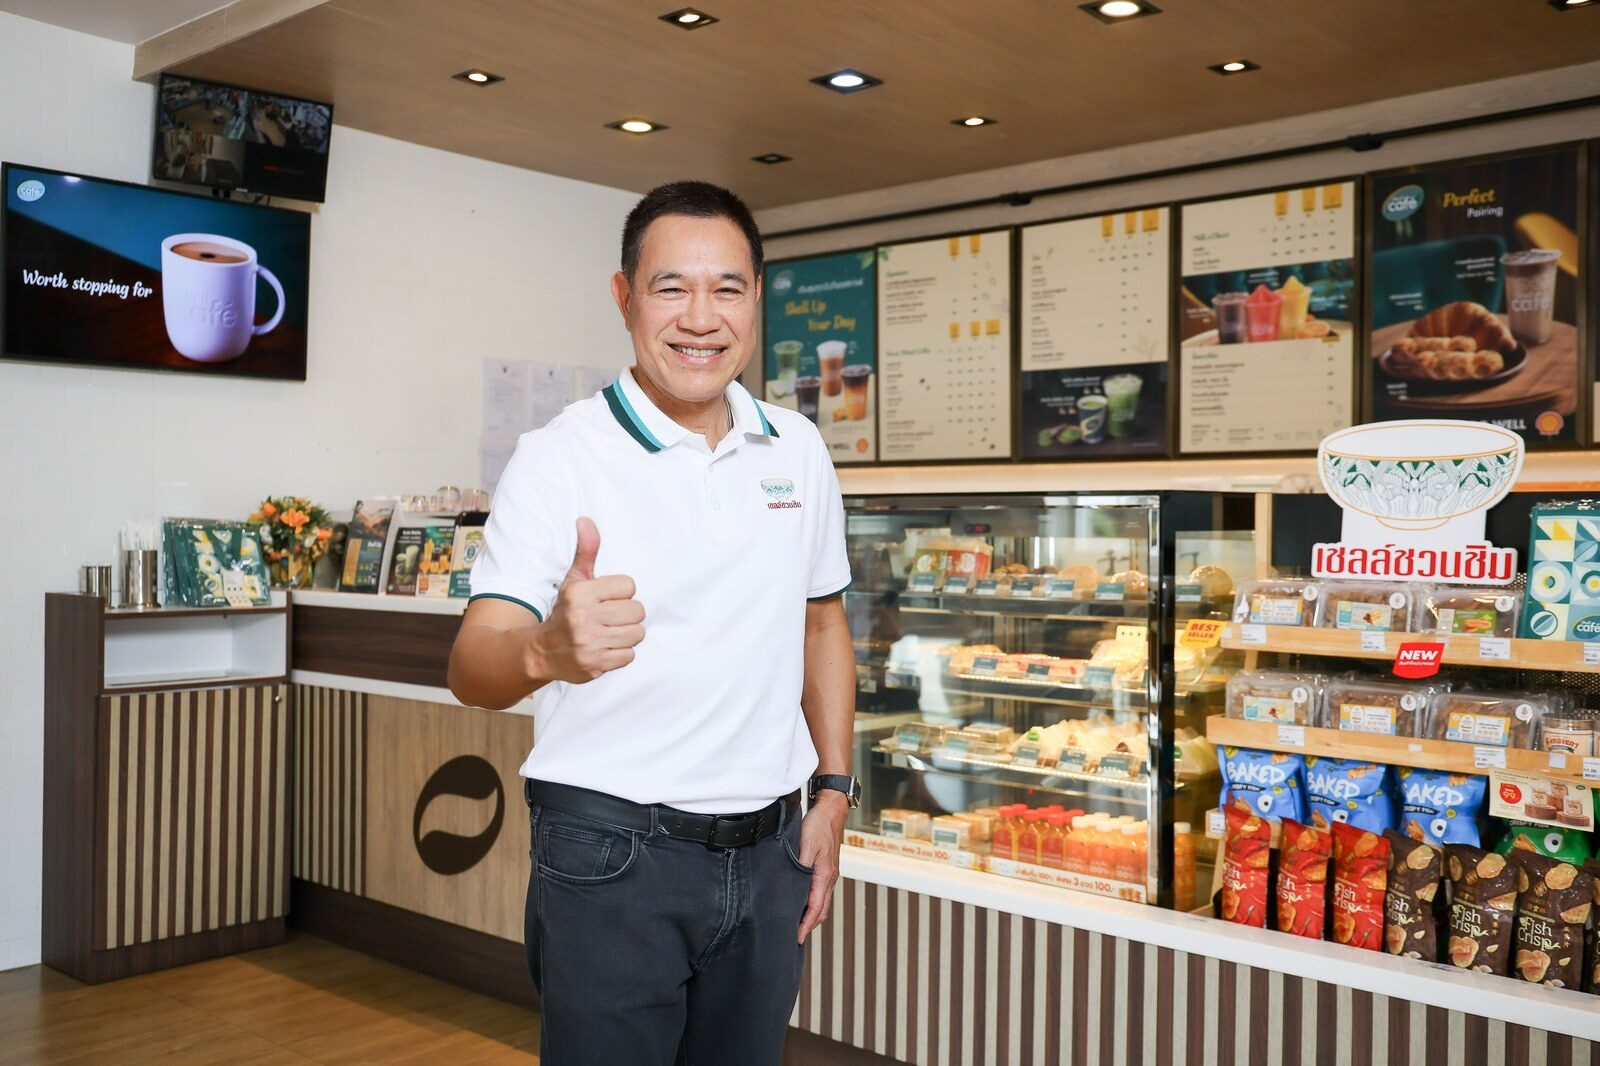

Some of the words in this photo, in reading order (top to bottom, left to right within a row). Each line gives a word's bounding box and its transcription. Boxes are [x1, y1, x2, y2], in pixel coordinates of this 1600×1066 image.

[1442, 188, 1496, 208] Perfect
[1466, 206, 1504, 218] Pairing
[22, 269, 69, 288] Worth
[71, 278, 130, 299] stopping
[132, 281, 153, 298] for
[1316, 543, 1512, 580] เชลล์ชวนชิม
[1190, 623, 1220, 632] BEST
[1399, 649, 1438, 661] NEW
[1226, 761, 1286, 786] BAKED
[1307, 771, 1361, 800] BAKED
[1402, 782, 1464, 807] AKED
[1451, 902, 1482, 924] Fish
[1450, 914, 1490, 938] Crisp
[1519, 916, 1553, 937] Fish
[1517, 926, 1561, 952] Crisp
